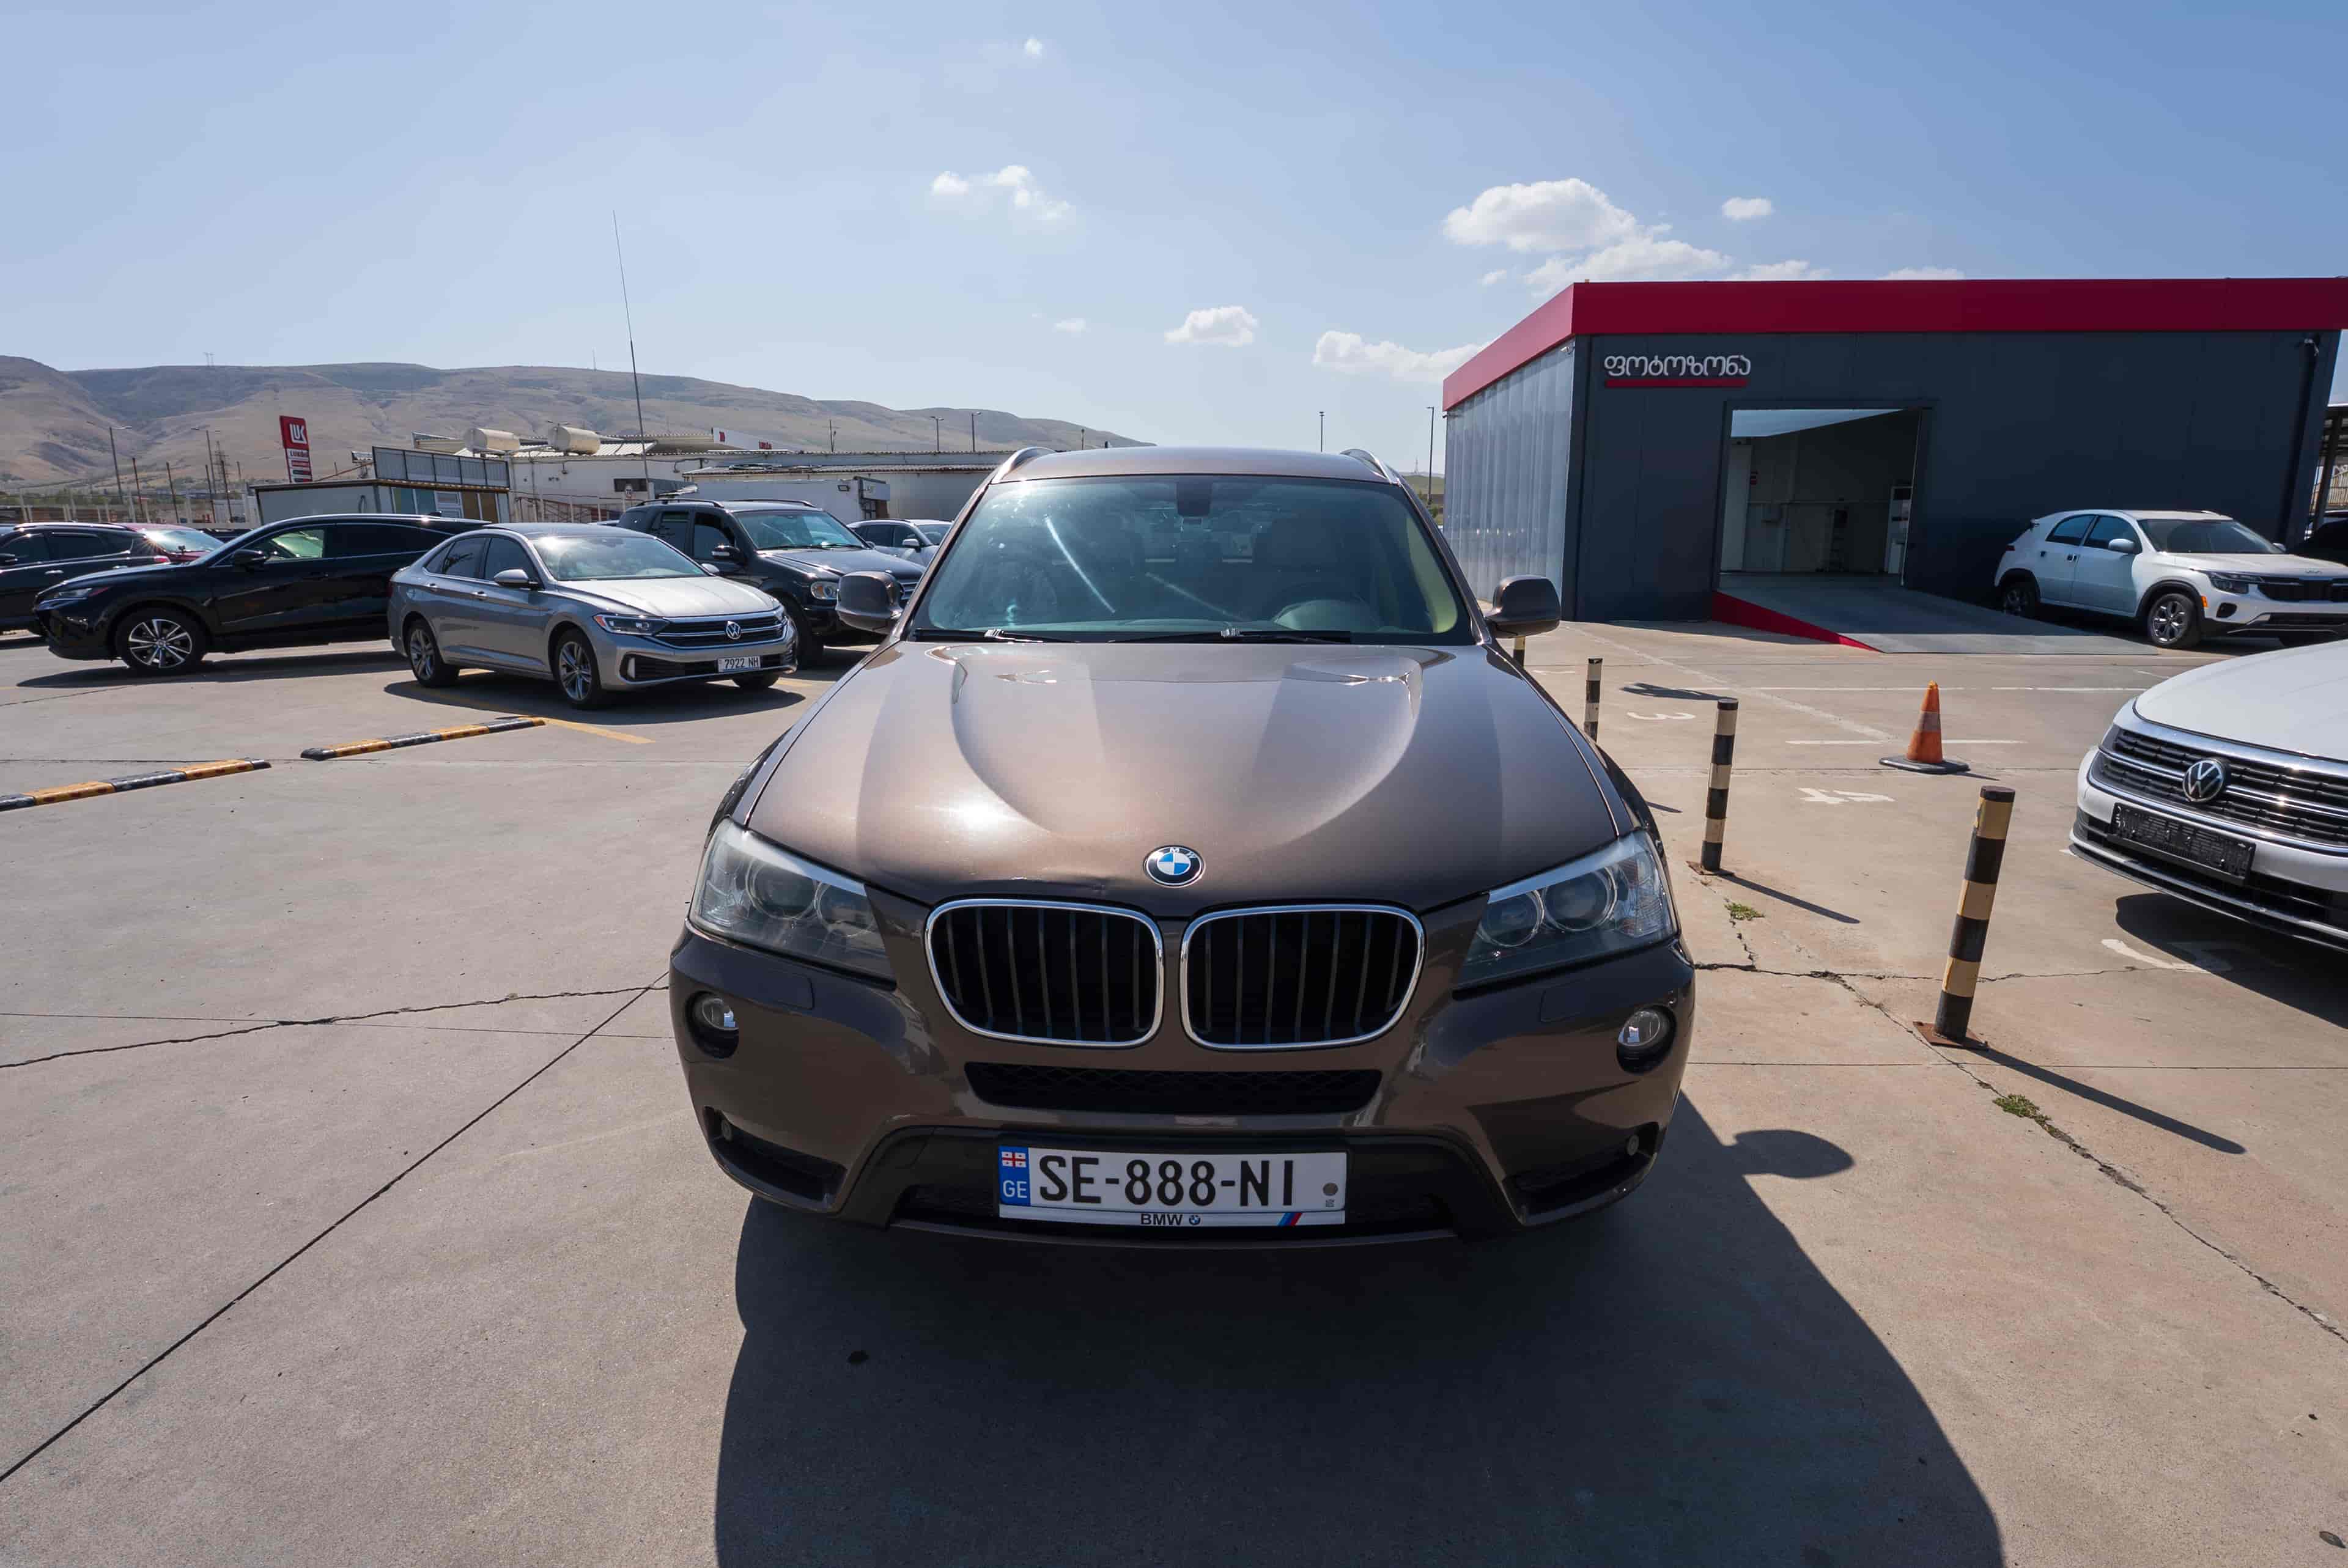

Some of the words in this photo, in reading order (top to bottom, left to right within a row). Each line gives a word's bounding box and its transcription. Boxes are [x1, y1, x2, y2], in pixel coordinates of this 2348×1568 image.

[1604, 355, 1751, 376] ფოტოზონა
[1003, 1180, 1027, 1198] GE
[1039, 1155, 1293, 1206] SE-888-NI
[1140, 1213, 1183, 1226] BMW
